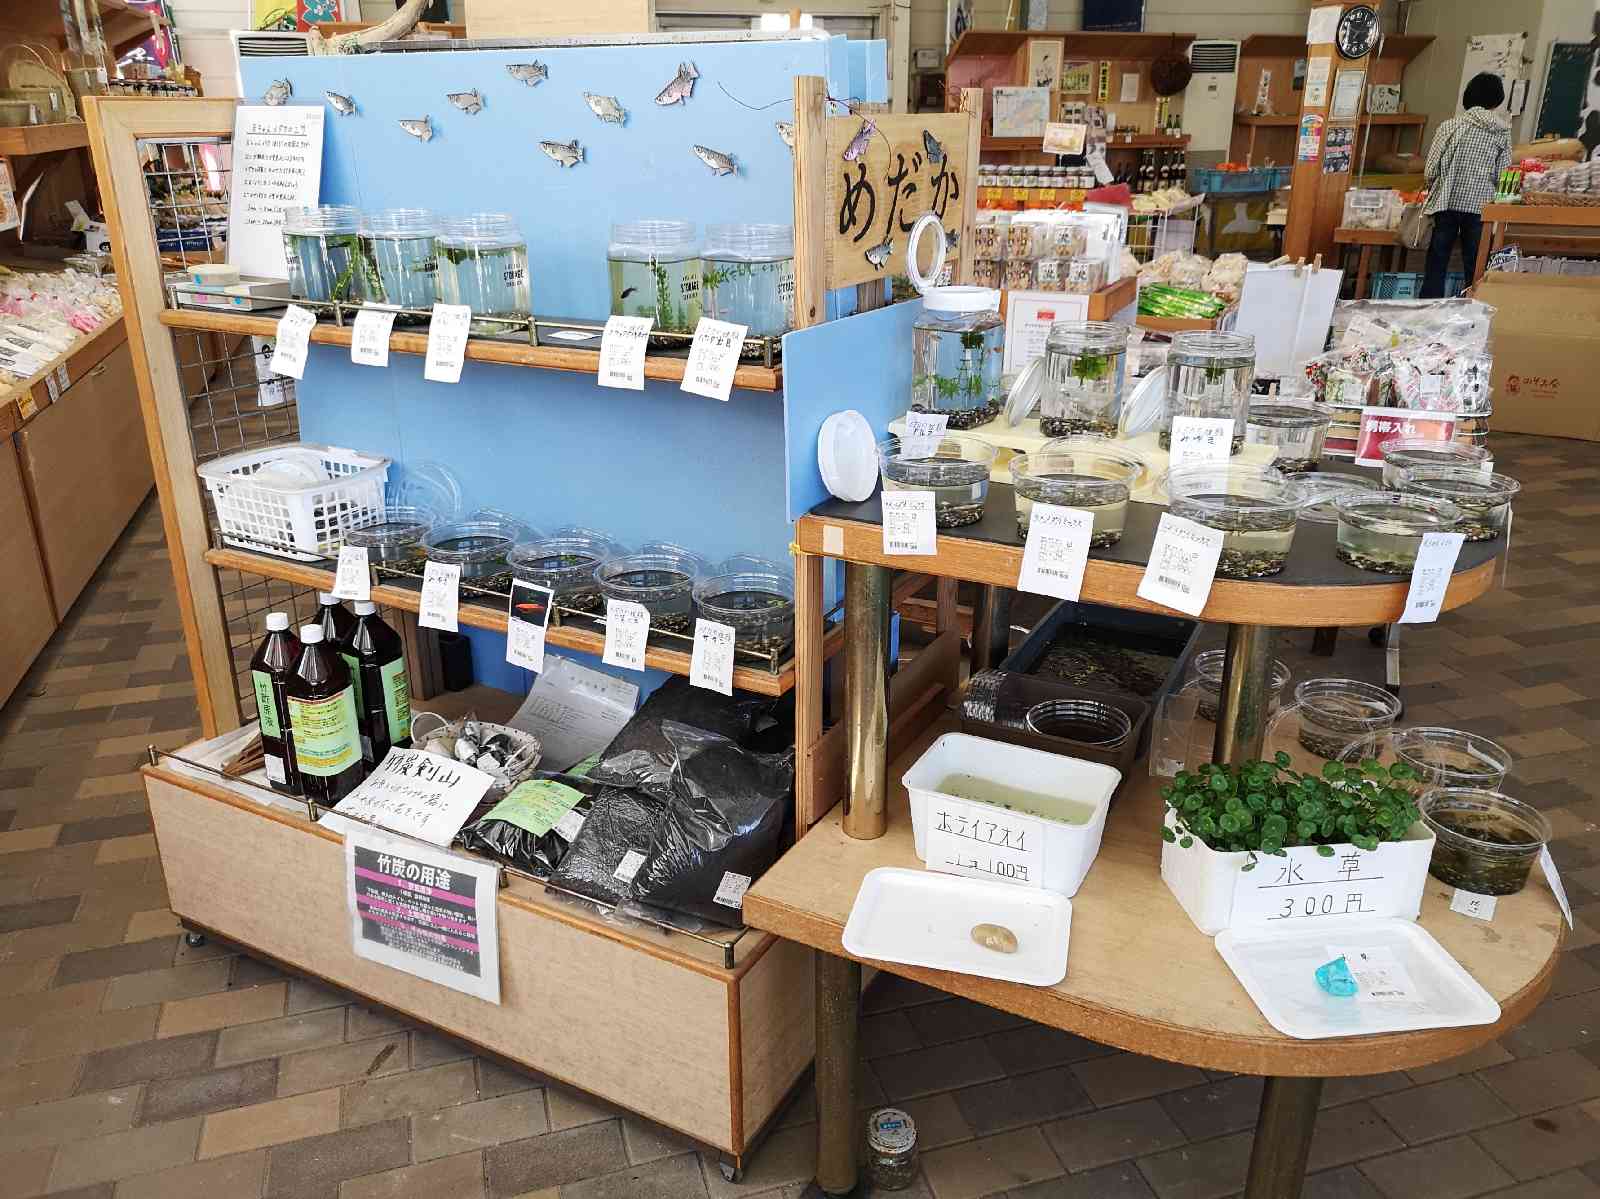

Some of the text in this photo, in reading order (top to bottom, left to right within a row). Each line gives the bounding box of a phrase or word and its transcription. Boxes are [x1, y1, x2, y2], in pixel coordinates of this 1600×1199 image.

[839, 151, 960, 242] めだか
[376, 854, 452, 891] 竹炭の用途
[1279, 893, 1363, 918] 300円
